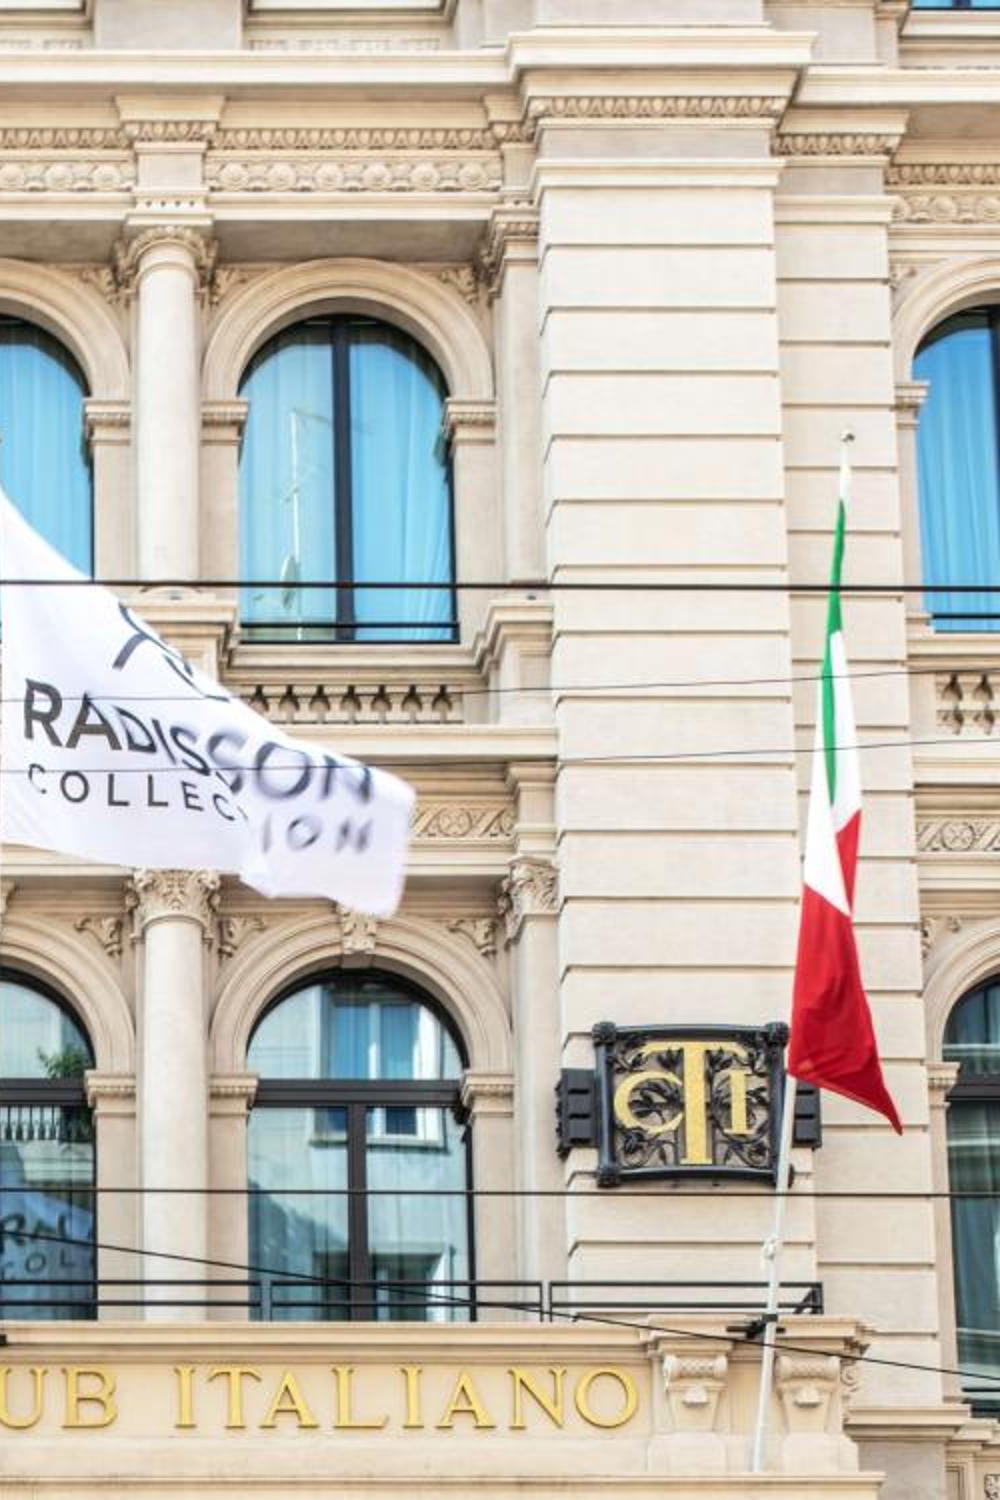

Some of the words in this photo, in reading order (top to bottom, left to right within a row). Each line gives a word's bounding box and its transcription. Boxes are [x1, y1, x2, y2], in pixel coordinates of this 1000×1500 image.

[22, 678, 373, 804] RADISSON
[27, 763, 373, 854] COLLECION
[173, 1366, 640, 1430] ITALIANO
